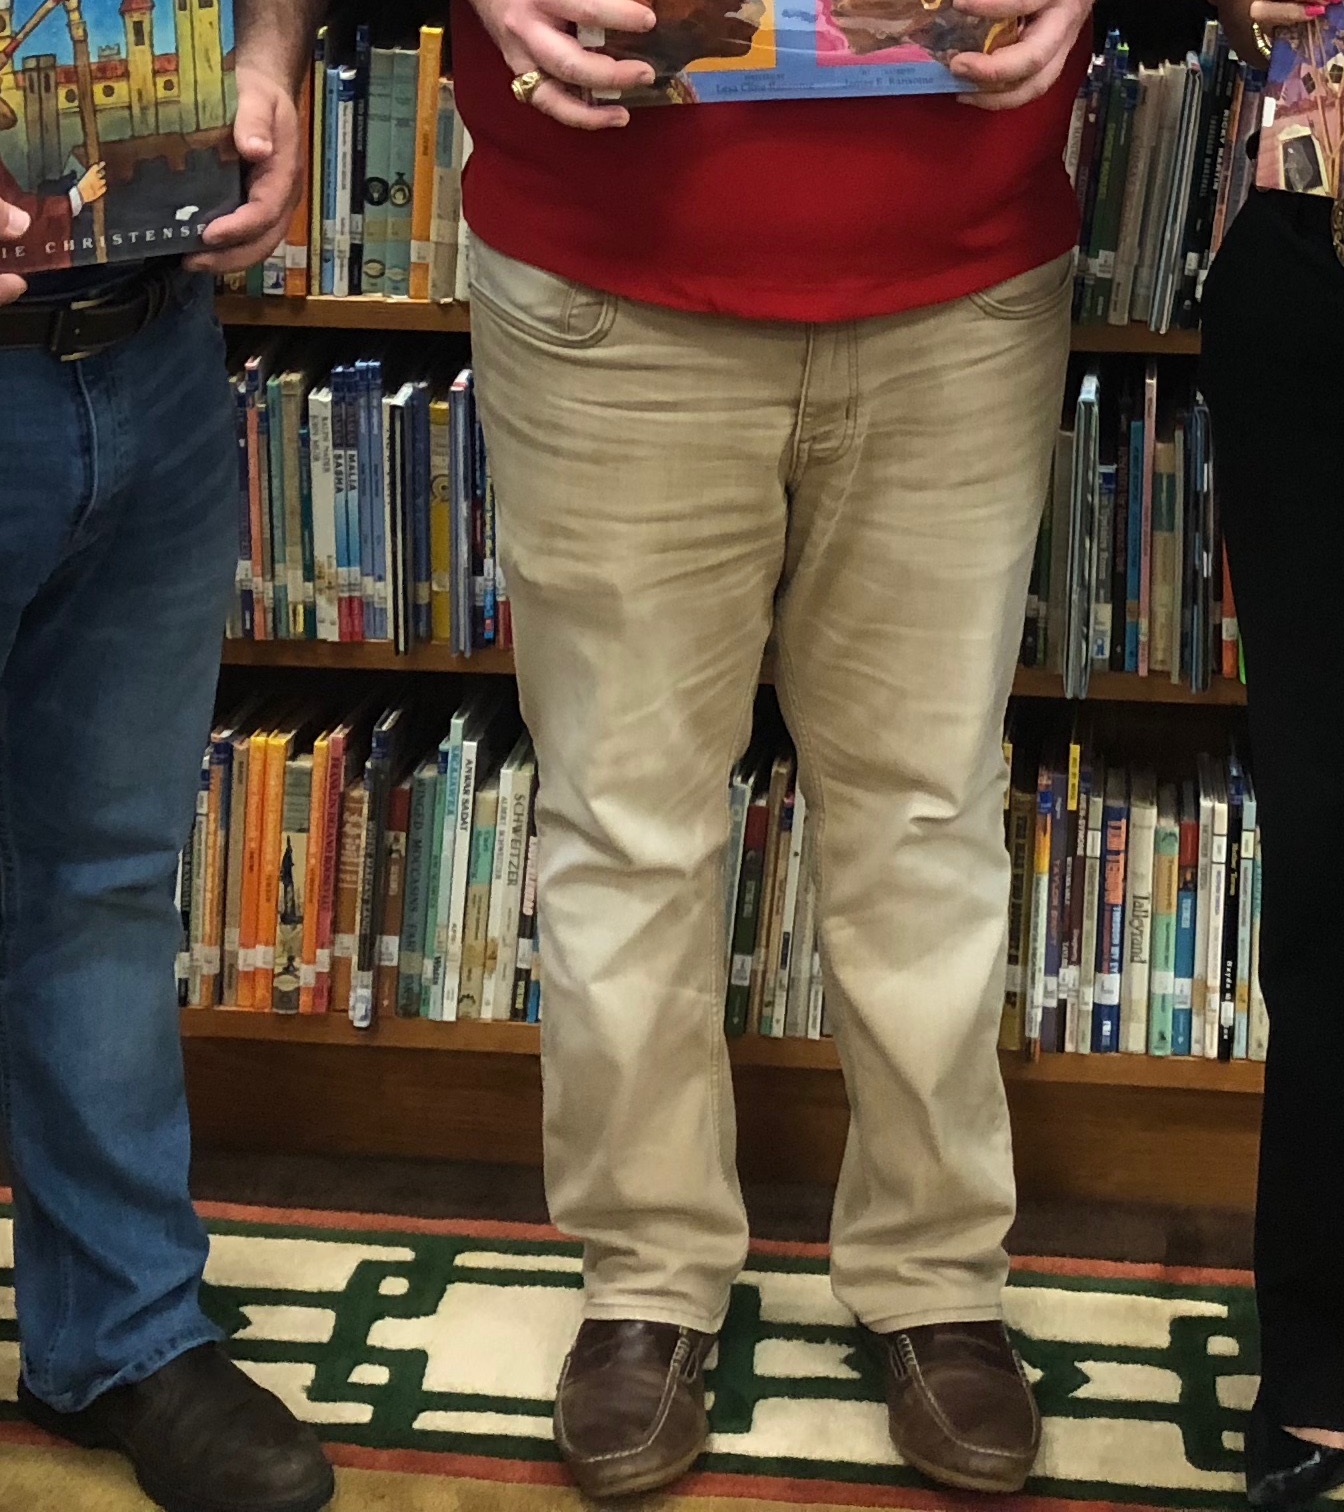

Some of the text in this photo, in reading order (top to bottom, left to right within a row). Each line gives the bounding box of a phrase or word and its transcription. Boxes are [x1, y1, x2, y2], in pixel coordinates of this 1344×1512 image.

[348, 453, 357, 491] MALIA
[460, 758, 474, 832] ANWAR SADAT
[506, 793, 526, 887] SCHWEITZER
[1129, 892, 1150, 964] Talleyrand
